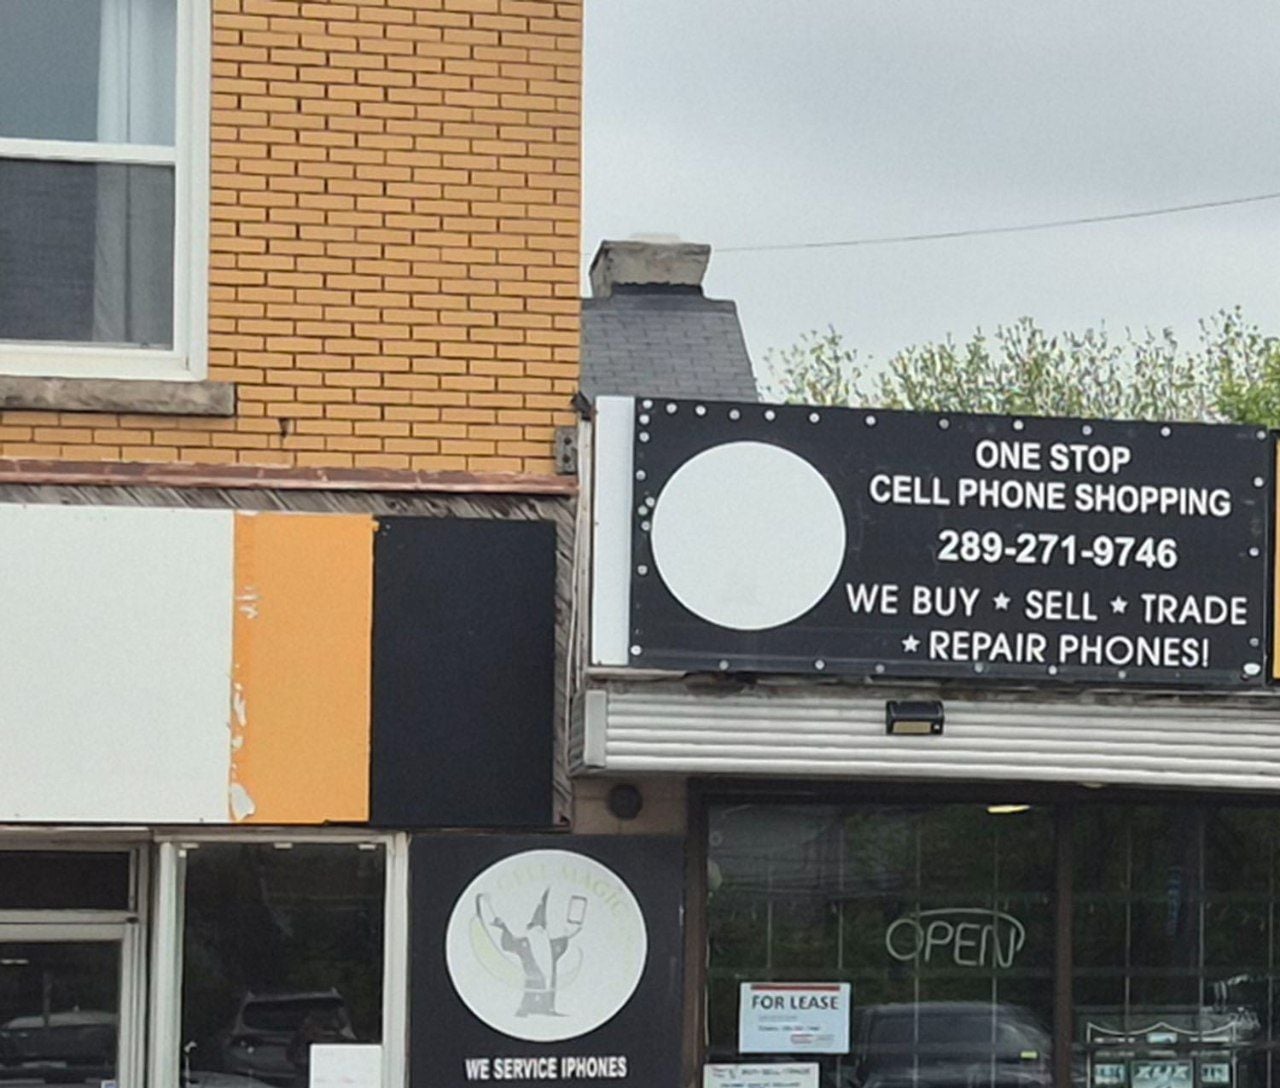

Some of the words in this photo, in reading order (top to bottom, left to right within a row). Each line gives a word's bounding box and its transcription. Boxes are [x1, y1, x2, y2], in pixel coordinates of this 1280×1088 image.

[975, 441, 1041, 472] ONE
[1050, 443, 1131, 474] STOP
[869, 475, 950, 505] CELL
[958, 478, 1064, 511] PHONE
[1074, 482, 1231, 517] SHOPPING
[937, 530, 1178, 569] 289-271-9746
[846, 583, 898, 613] WE
[912, 586, 980, 617] BUY
[1025, 591, 1097, 621] SELL
[1141, 594, 1247, 625] TRADE
[929, 630, 1045, 662] REPAIR
[1059, 635, 1210, 668] PHONES!
[886, 912, 1020, 968] OPEN
[752, 995, 784, 1010] FOR
[791, 995, 839, 1010] LEASE
[465, 1059, 491, 1079] WE
[493, 1057, 558, 1079] SERVICE
[560, 1057, 627, 1078] IPHONES
